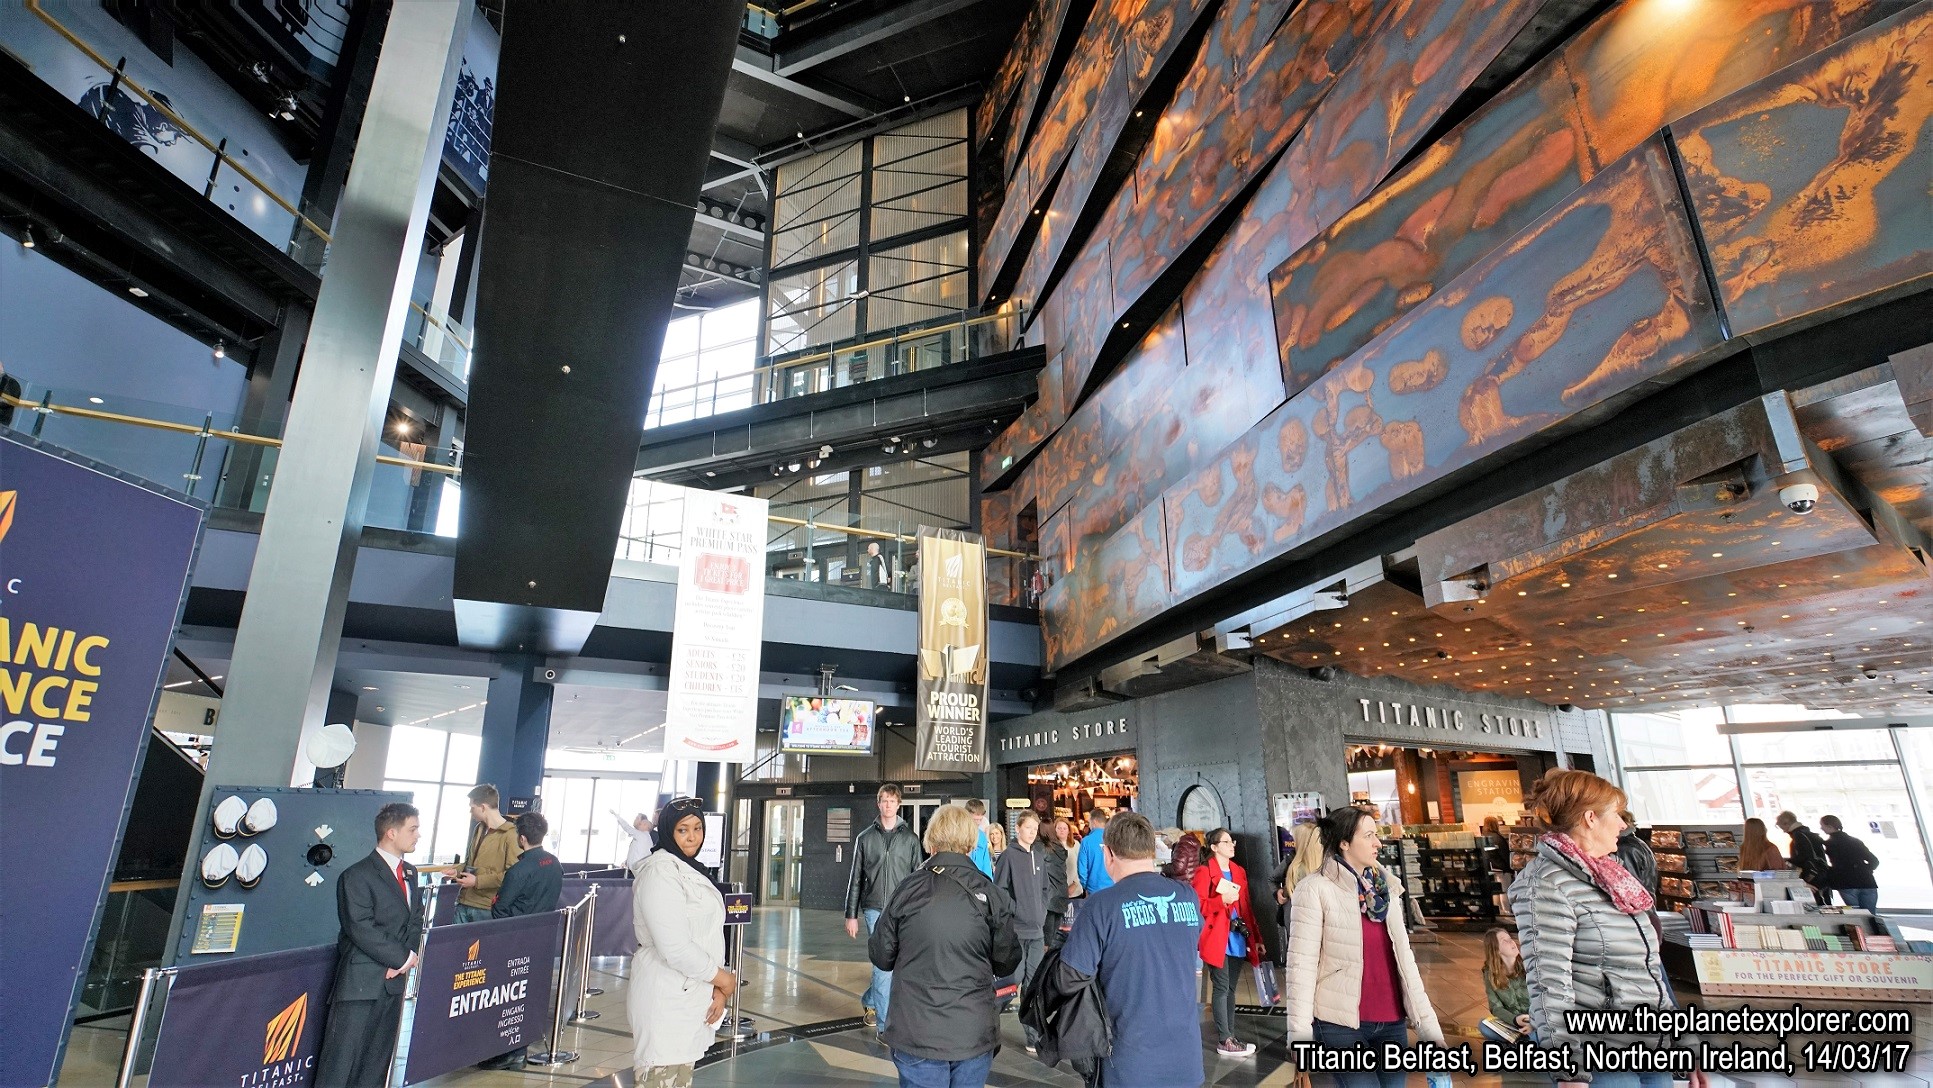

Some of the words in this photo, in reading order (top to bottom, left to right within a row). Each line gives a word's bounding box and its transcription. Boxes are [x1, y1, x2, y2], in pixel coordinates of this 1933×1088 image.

[697, 527, 726, 540] WHITE
[730, 530, 753, 543] STAR
[690, 537, 734, 550] PREMIUM
[737, 542, 758, 555] PASS
[0, 616, 110, 676] NIC
[687, 649, 715, 658] ADULTS
[732, 653, 746, 662] £25
[686, 660, 717, 670] SENIORS
[731, 663, 746, 673] £20
[685, 671, 723, 681] STUDENTS
[731, 674, 746, 683] £20
[684, 681, 722, 692] CHILDREN
[930, 691, 978, 708] PROUD
[927, 704, 980, 721] WINNER
[1360, 698, 1464, 731] TITANIC
[1481, 713, 1544, 739] STORE
[934, 725, 974, 737] WORLD'S
[1000, 730, 1059, 751] TITANIC
[1072, 718, 1128, 740] STORE
[935, 735, 973, 745] LEADING
[936, 743, 972, 753] TOURIST
[927, 752, 980, 763] ATTRACTION
[1467, 779, 1520, 788] ENGRAVIN
[1477, 787, 1520, 795] STATION
[1121, 904, 1157, 929] PECOS
[462, 959, 482, 967] TITANIC
[507, 956, 531, 968] ENTRADA
[1753, 959, 1824, 973] TITANIC
[1836, 961, 1893, 975] STORE
[454, 973, 465, 981] THE
[465, 968, 487, 980] TITANIC
[510, 965, 530, 977] ENTRÉE
[453, 976, 486, 990] EXPERIENCE
[1735, 972, 1754, 980] FOR
[1756, 972, 1774, 980] THE
[1778, 973, 1819, 982] PERFECT
[1823, 974, 1845, 982] GIFT
[1849, 975, 1862, 983] OR
[1866, 975, 1918, 985] SOUVENIR
[449, 979, 528, 1018] ENTRANCE
[501, 1004, 525, 1018] EINGANG
[497, 1014, 524, 1029] INGRESSO
[508, 1034, 521, 1046] 入口
[240, 1055, 313, 1088] TITANIC
[250, 1073, 300, 1088] FAST
